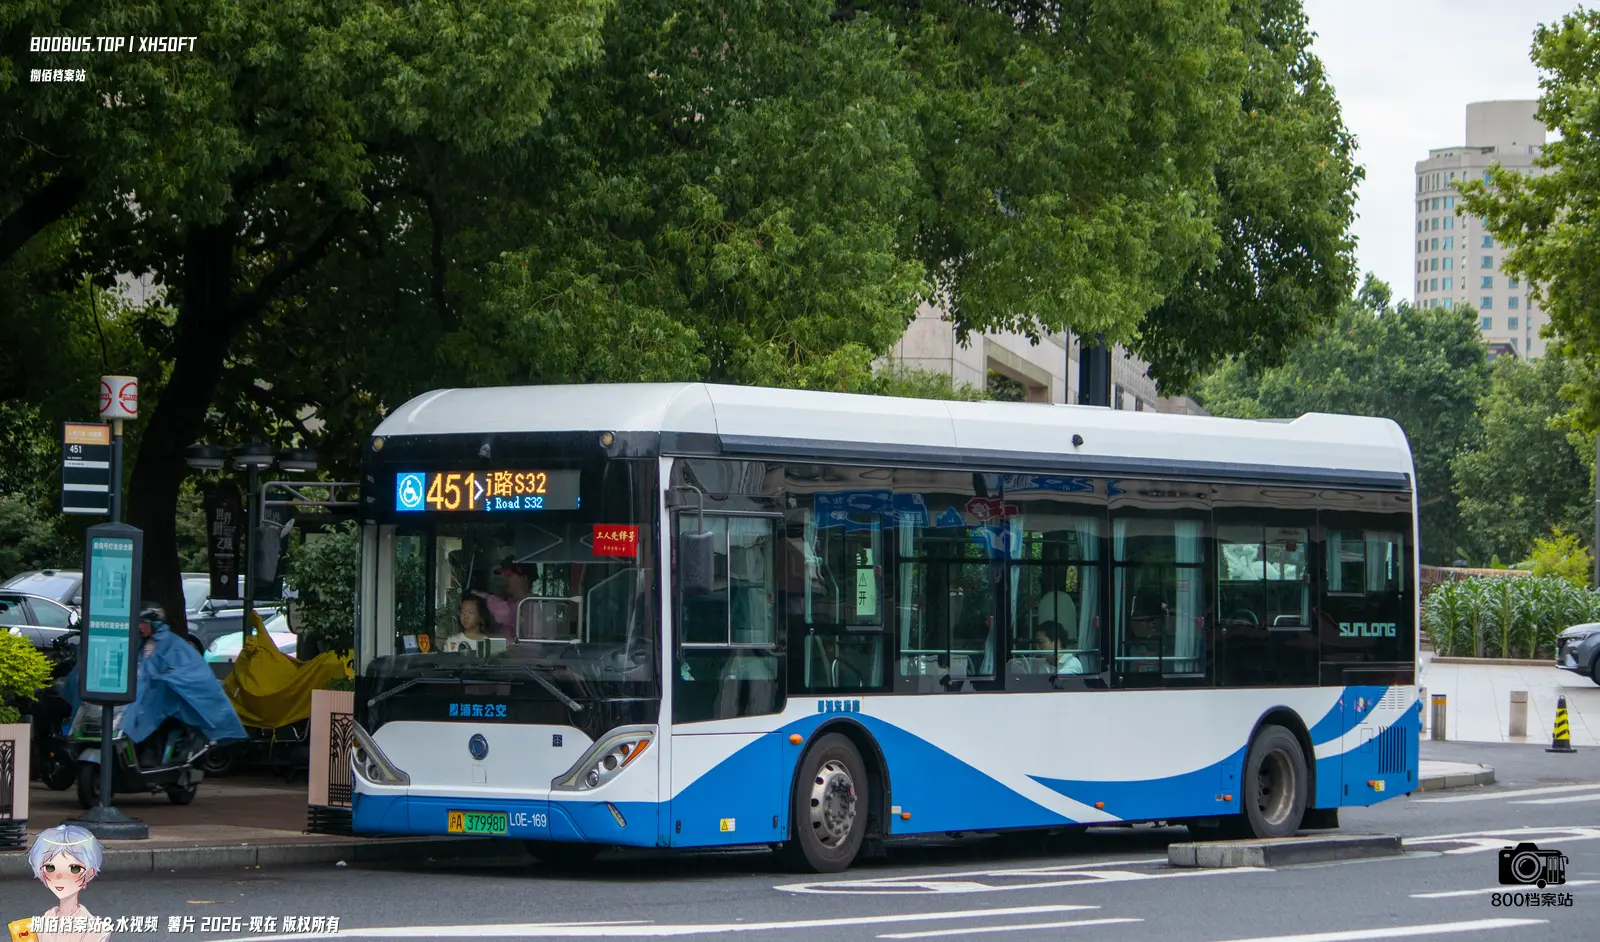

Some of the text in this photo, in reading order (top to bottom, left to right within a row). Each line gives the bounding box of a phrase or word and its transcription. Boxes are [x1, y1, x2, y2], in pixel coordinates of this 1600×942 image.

[69, 444, 82, 454] 451
[426, 472, 475, 510] 451
[495, 497, 520, 509] Road
[524, 497, 543, 509] S32
[596, 530, 636, 543] 工人先锋号
[1339, 622, 1396, 637] SUNLONG
[460, 703, 507, 717] 浦东公交
[467, 815, 506, 832] 37998D
